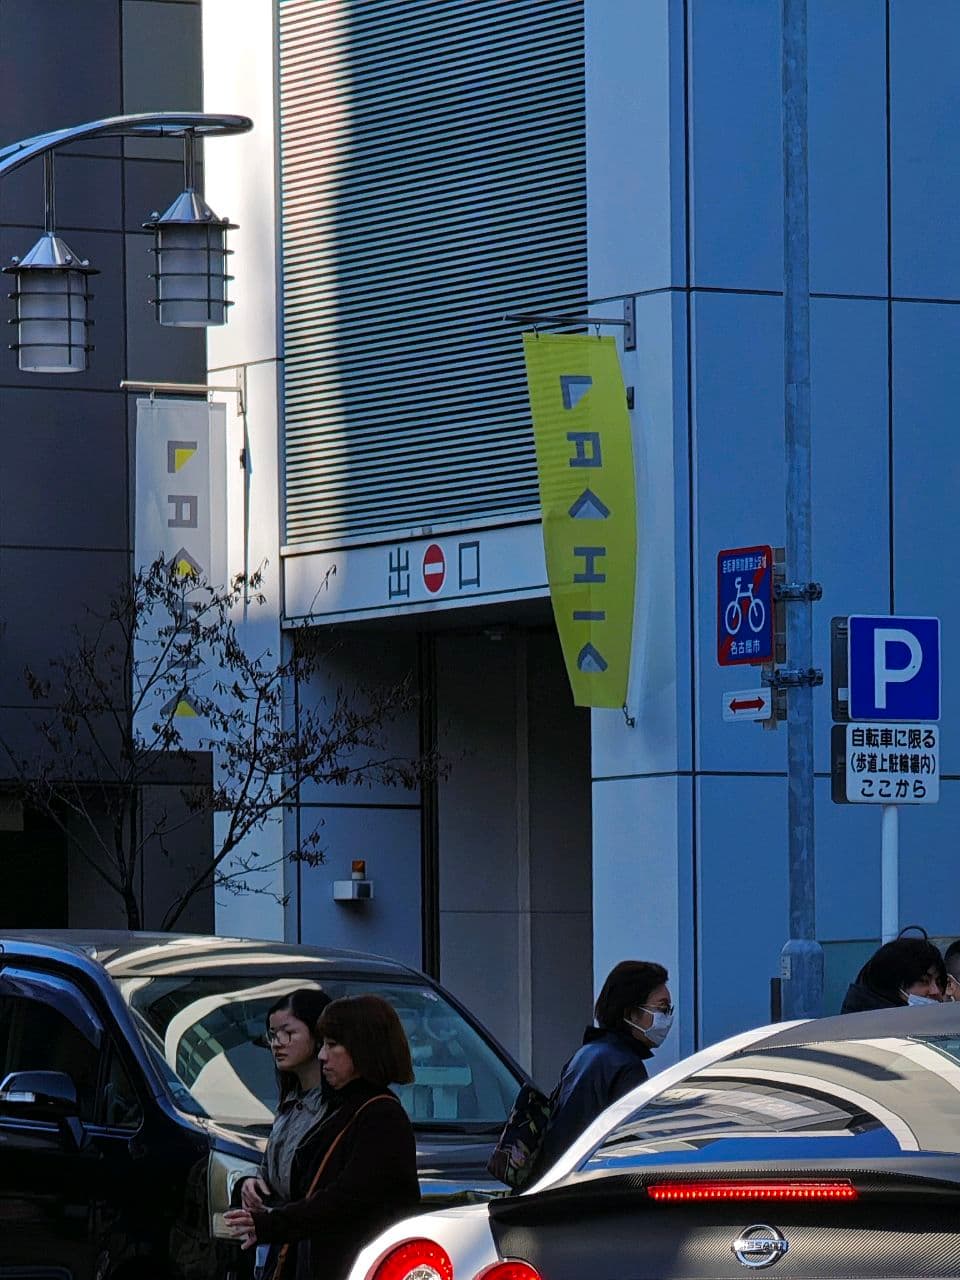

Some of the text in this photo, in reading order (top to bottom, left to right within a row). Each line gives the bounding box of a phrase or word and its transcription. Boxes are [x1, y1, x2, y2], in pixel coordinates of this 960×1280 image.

[873, 628, 923, 710] P
[851, 727, 936, 749] 自転車に限る
[861, 779, 927, 798] ここから
